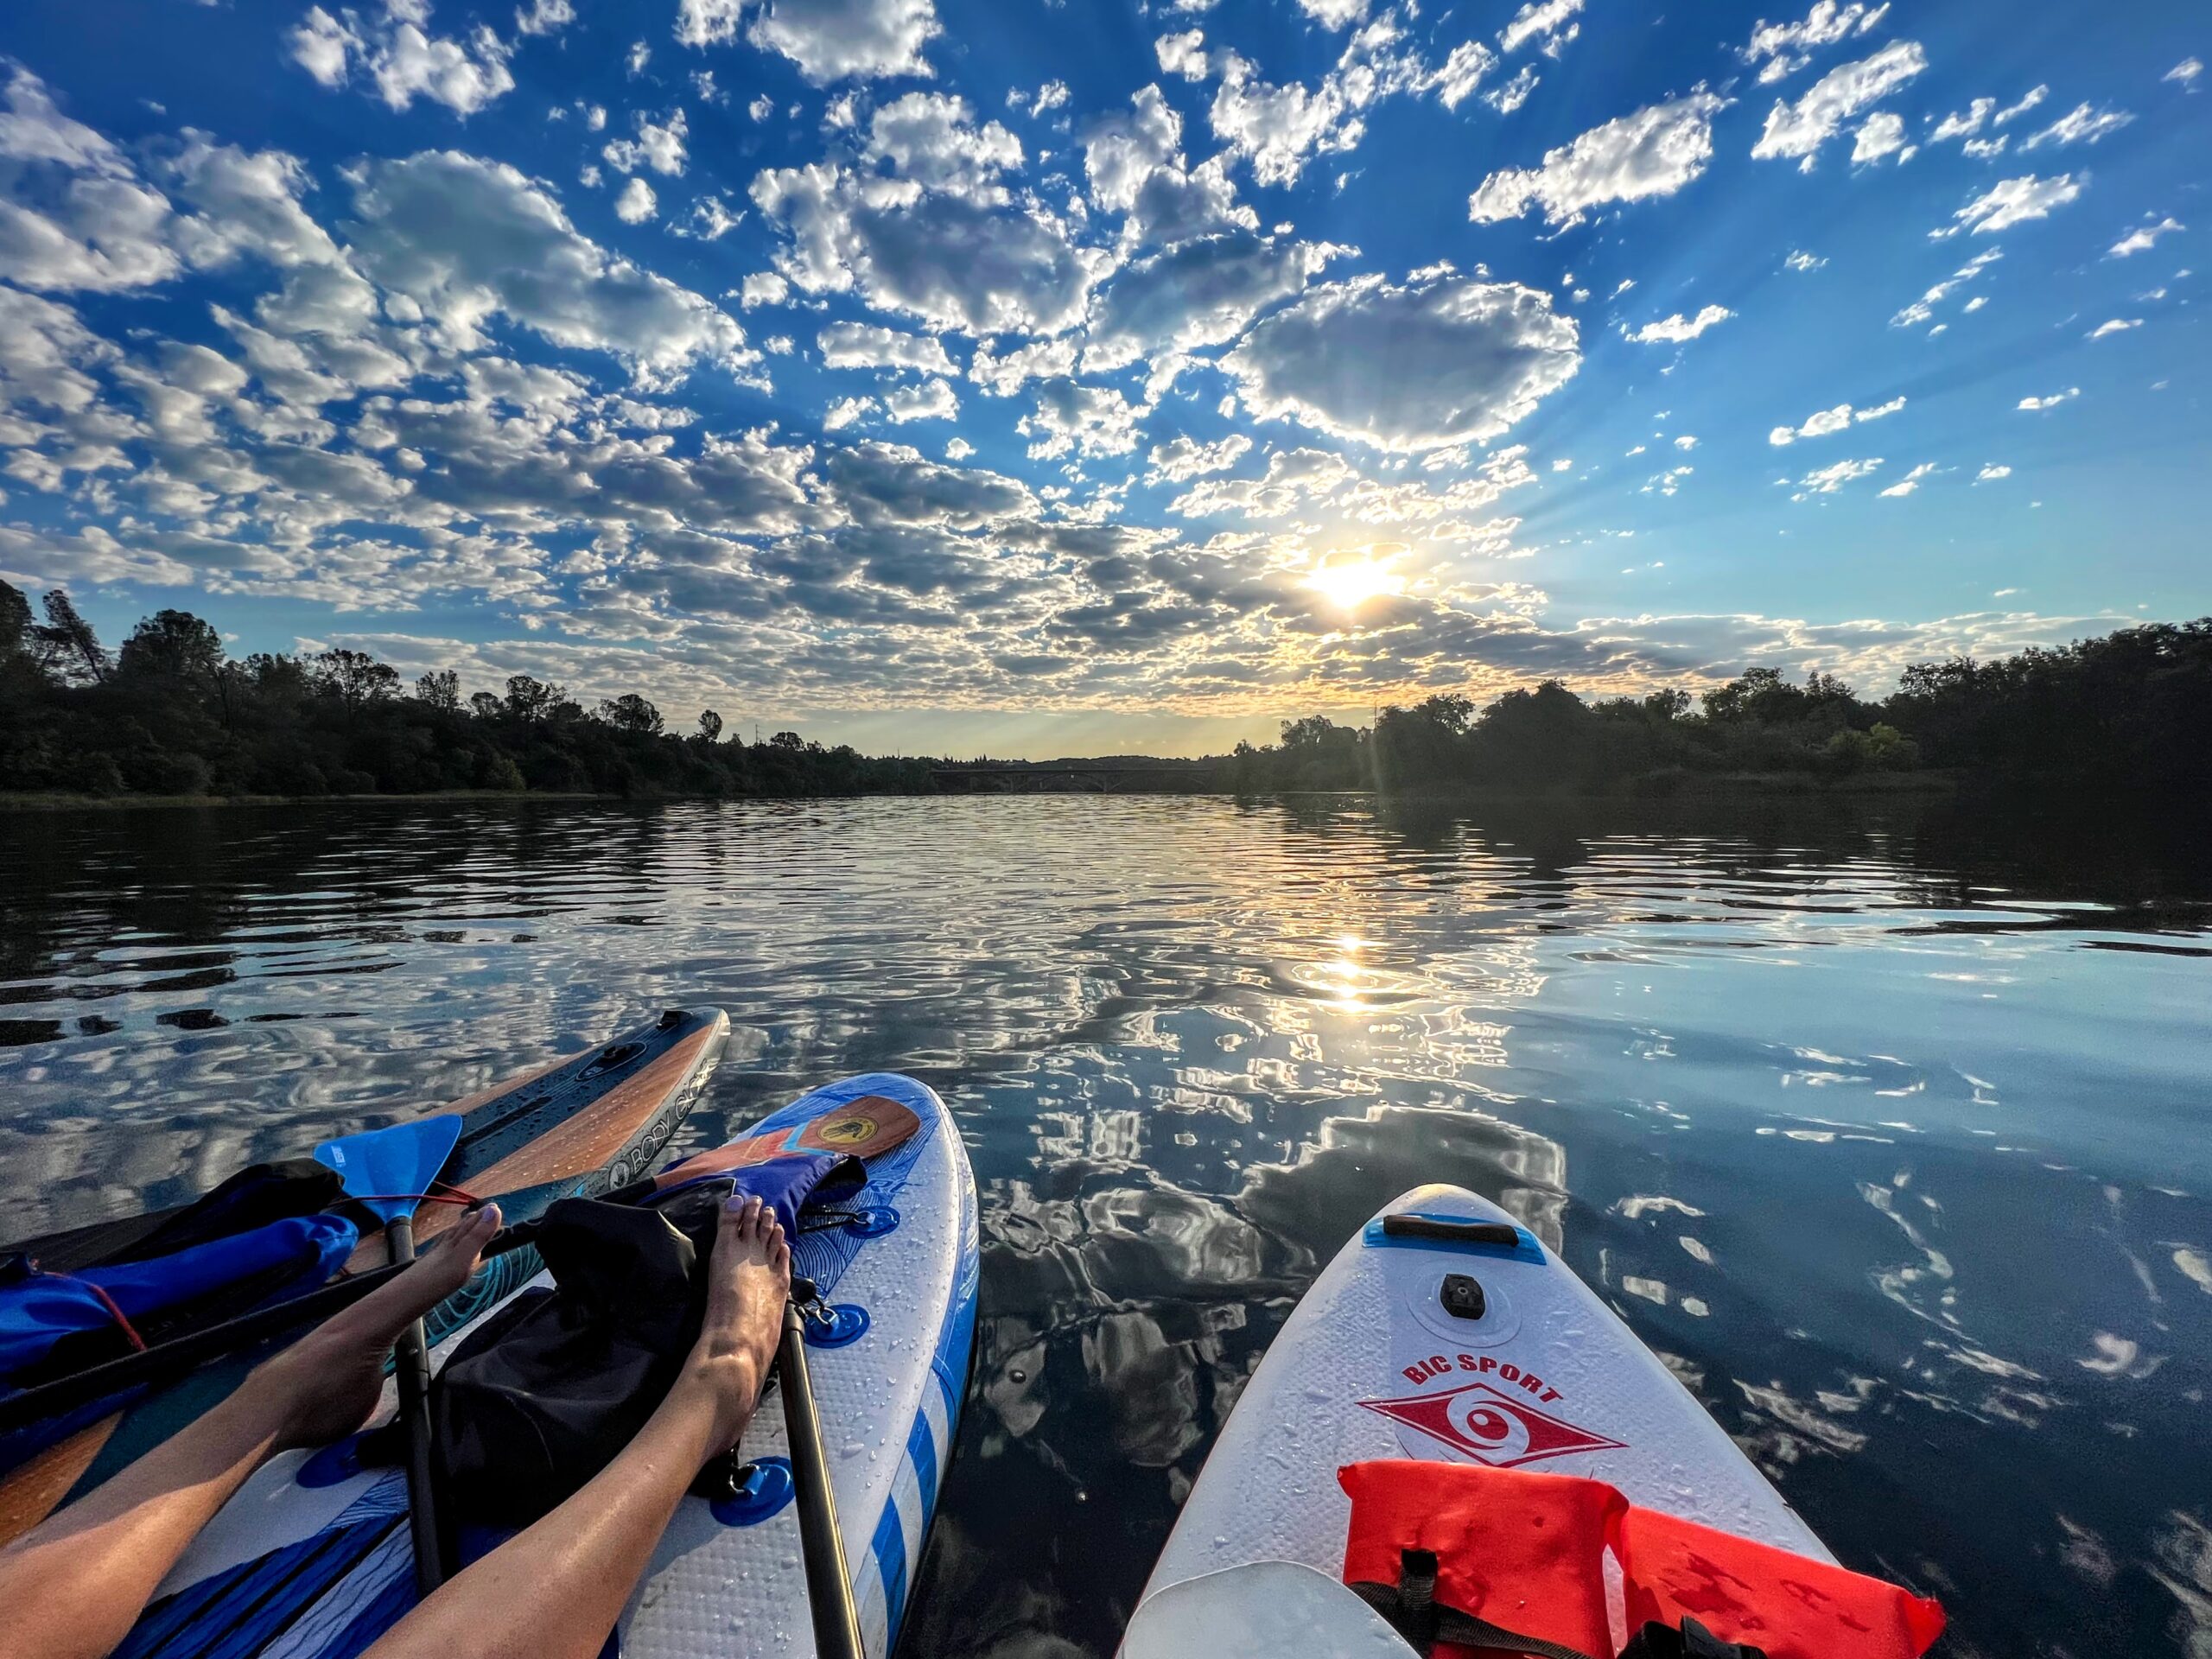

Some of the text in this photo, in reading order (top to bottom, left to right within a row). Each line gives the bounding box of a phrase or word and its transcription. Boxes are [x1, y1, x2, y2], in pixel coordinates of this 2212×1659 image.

[629, 1057, 721, 1175] BODY GLO
[1402, 1353, 1564, 1403] BIC SPORT
